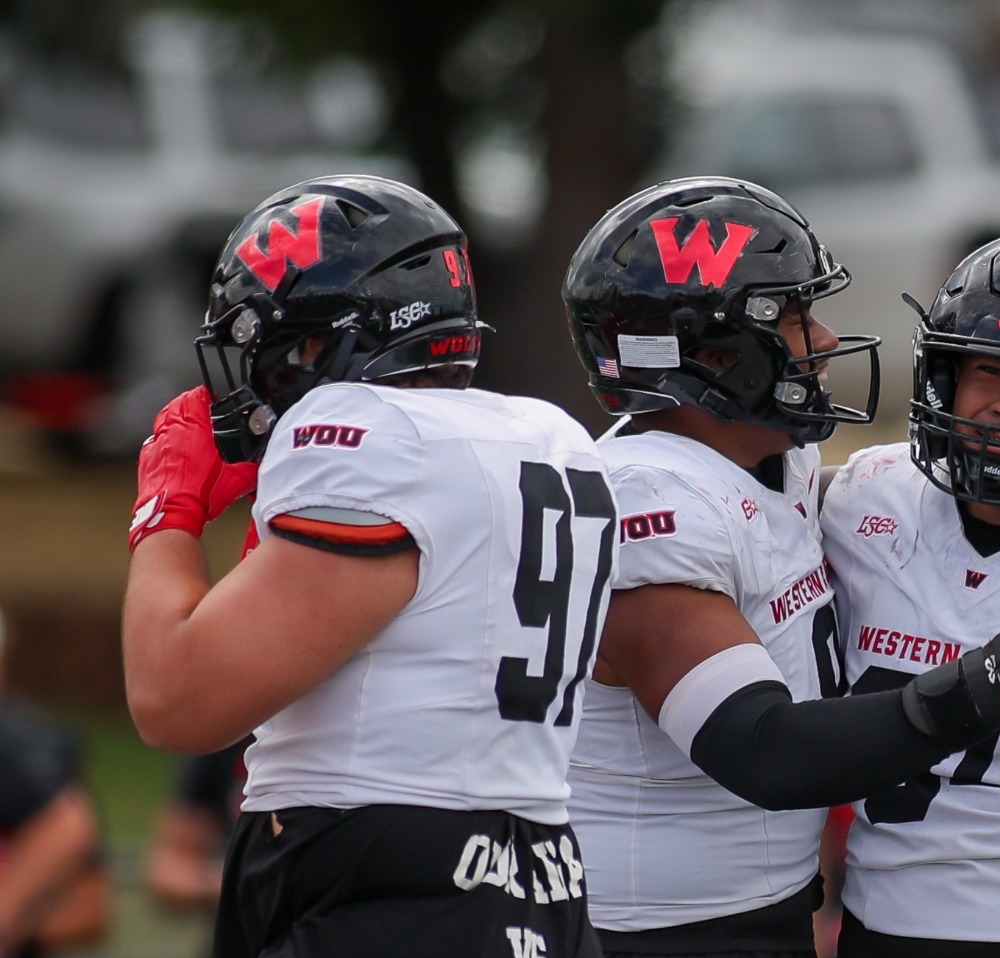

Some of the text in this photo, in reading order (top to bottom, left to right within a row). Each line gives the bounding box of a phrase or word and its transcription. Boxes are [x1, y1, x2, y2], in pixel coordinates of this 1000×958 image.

[234, 197, 326, 291] W
[649, 217, 757, 288] W
[291, 424, 371, 450] WOU
[619, 510, 678, 545] OU
[494, 460, 616, 727] 97
[769, 570, 826, 625] WESTERN
[965, 569, 989, 589] W
[857, 625, 961, 666] WESTERN
